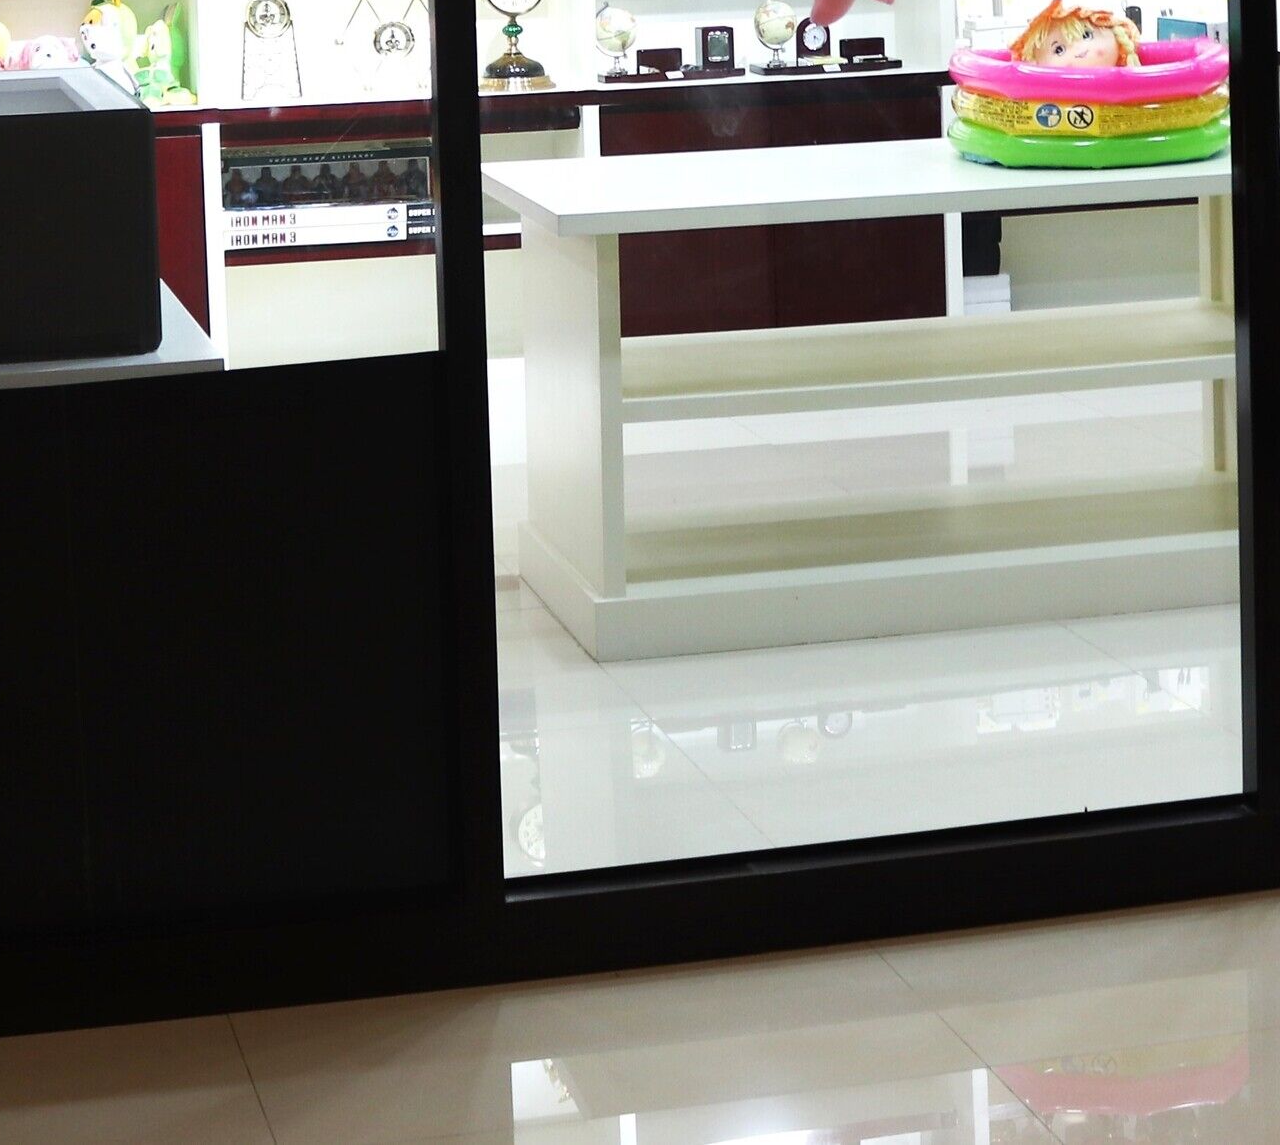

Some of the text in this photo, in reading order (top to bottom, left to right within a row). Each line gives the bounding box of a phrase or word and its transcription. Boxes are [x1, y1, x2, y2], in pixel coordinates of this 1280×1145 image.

[231, 213, 296, 227] IRON MAN 3
[231, 232, 297, 246] IRON MAN 3
